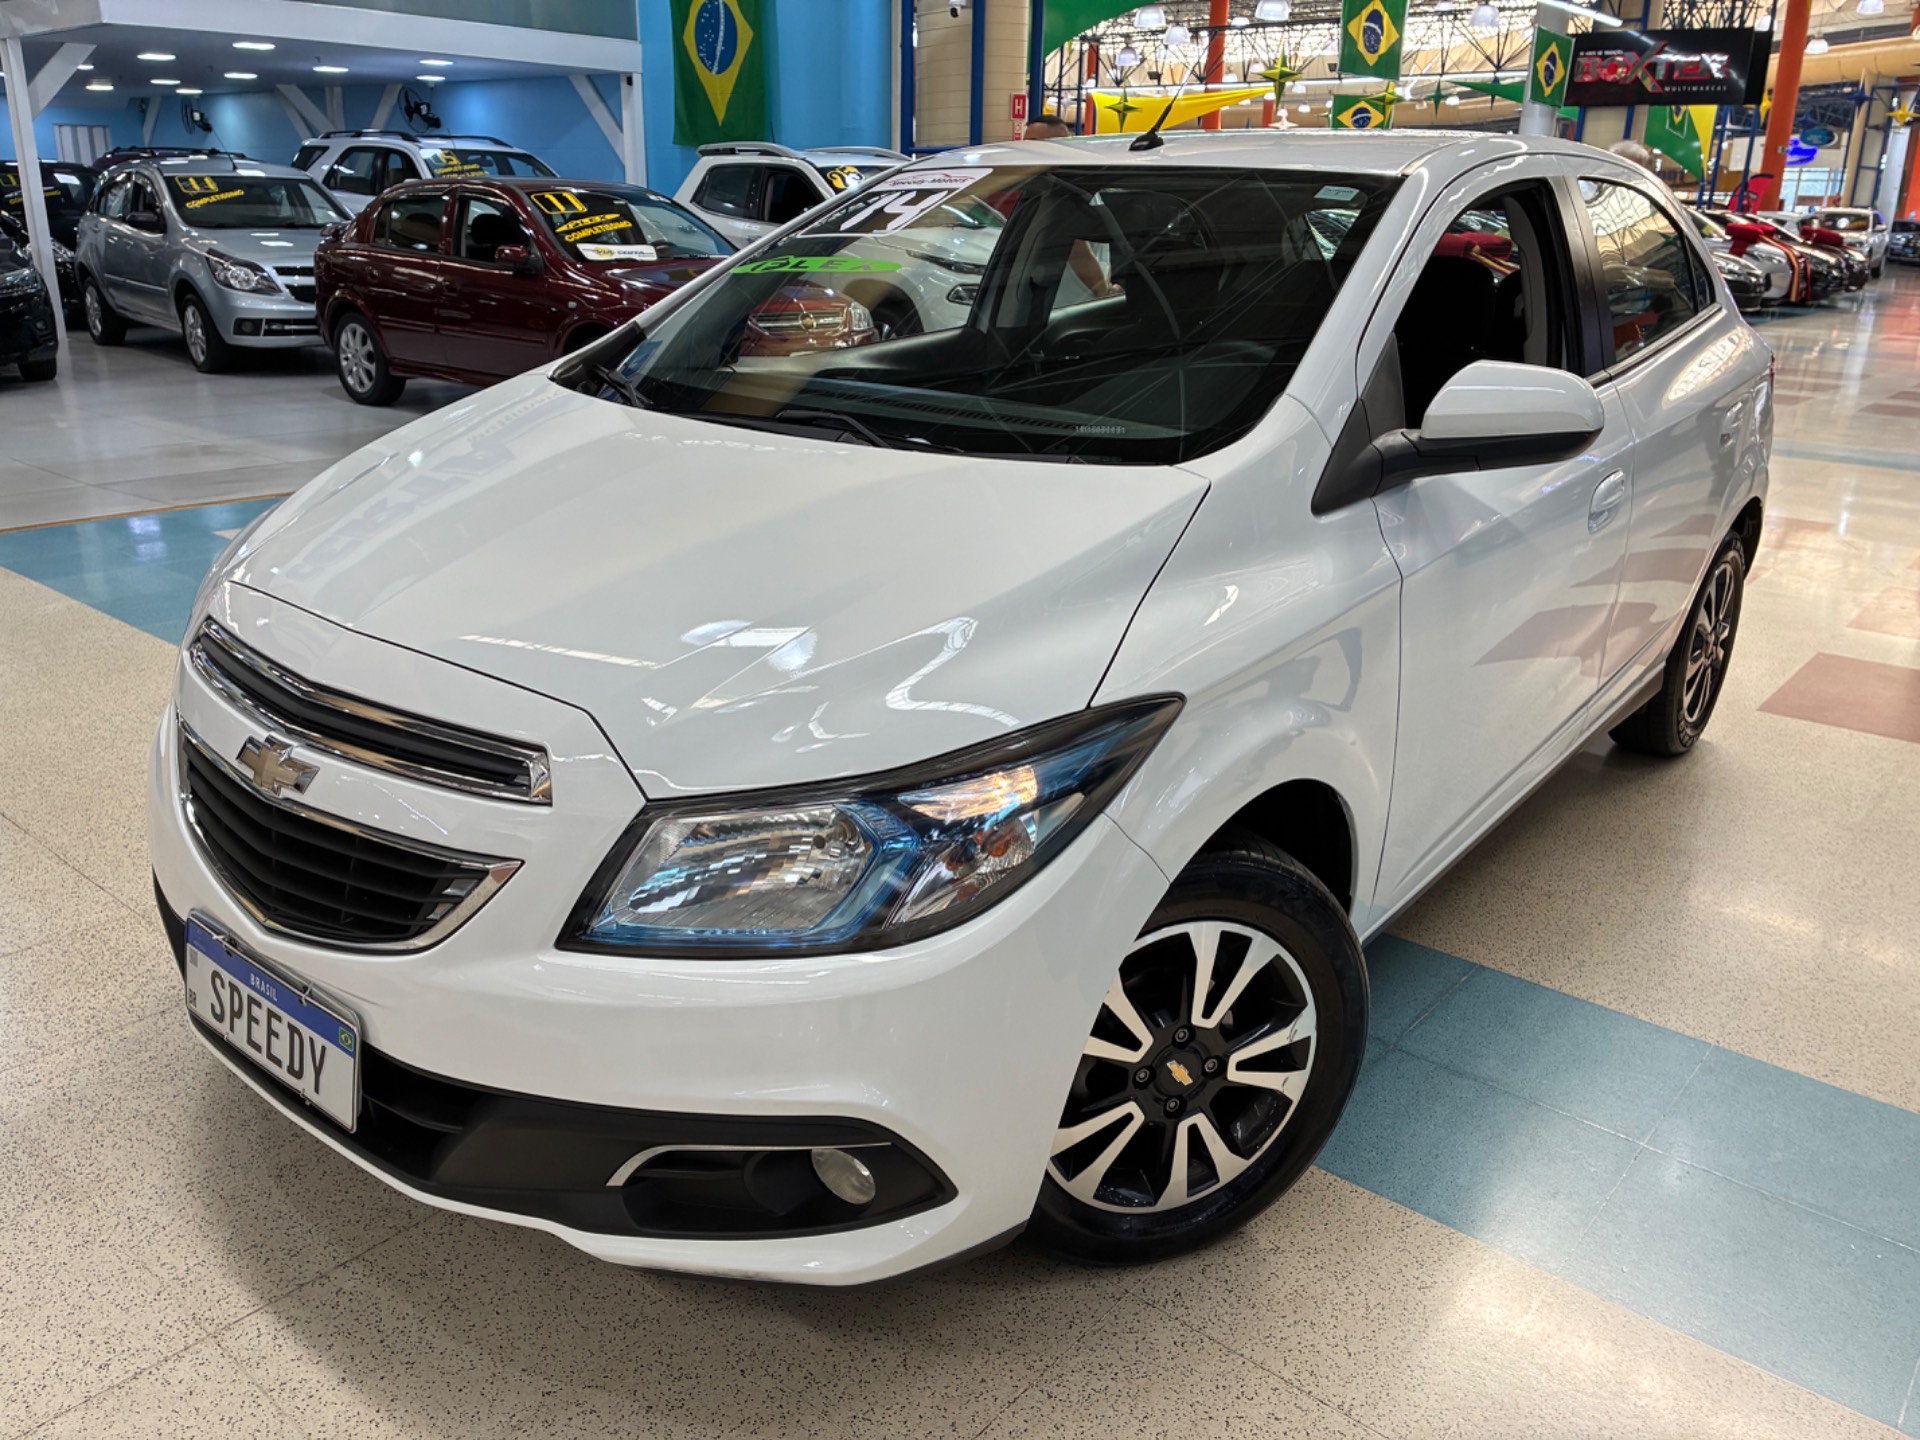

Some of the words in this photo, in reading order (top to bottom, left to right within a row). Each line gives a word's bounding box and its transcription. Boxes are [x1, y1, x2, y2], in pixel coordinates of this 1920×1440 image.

[1574, 41, 1730, 93] BOXTER
[1664, 84, 1728, 92] MULTIMARCAS
[1014, 98, 1023, 115] H
[544, 192, 587, 213] 11
[840, 190, 948, 233] 14
[249, 972, 278, 1001] BRASIL
[210, 969, 326, 1095] SPEEDY
